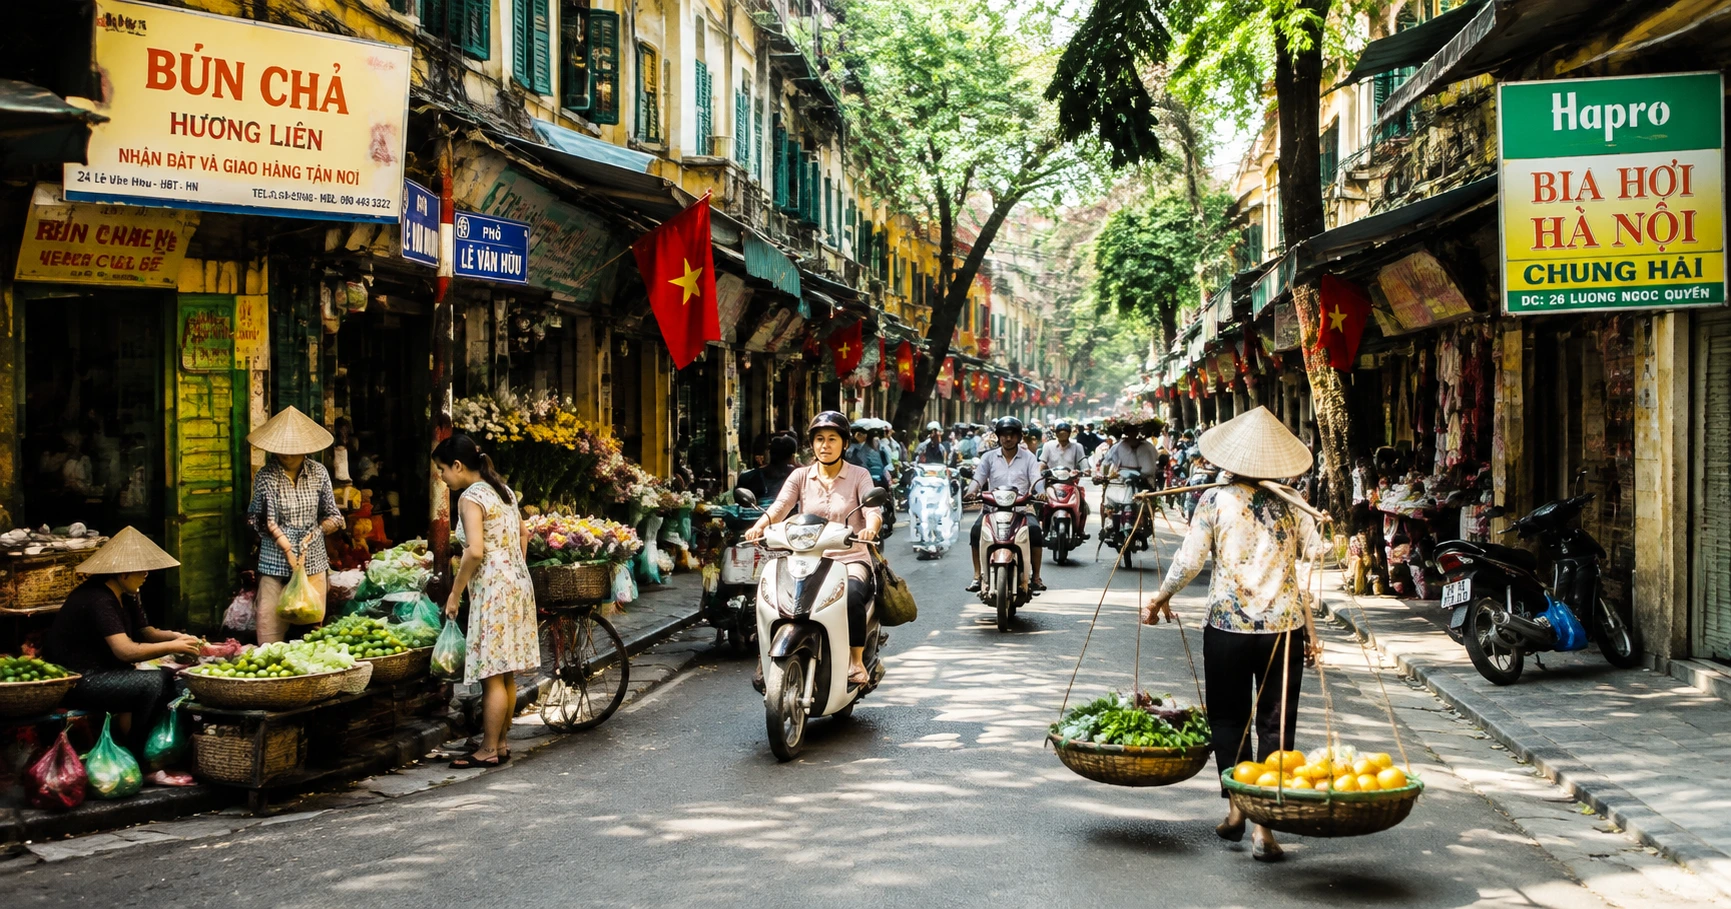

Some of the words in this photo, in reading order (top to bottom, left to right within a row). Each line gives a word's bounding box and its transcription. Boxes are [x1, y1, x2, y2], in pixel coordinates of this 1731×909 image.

[146, 43, 245, 101] BÚN
[260, 62, 349, 115] CHẢ
[170, 112, 261, 143] HƯƠNG
[270, 121, 323, 151] LIÊN
[1552, 91, 1670, 142] Hapro
[77, 171, 91, 182] 24
[186, 181, 199, 192] HN
[223, 159, 258, 175] GIAO
[1530, 167, 1605, 203] BIA
[1530, 205, 1601, 250] HÀ
[1611, 201, 1699, 252] NỘI
[1523, 261, 1637, 285] CHUNG
[1549, 294, 1565, 306] 26
[1570, 291, 1616, 304] LUONG
[1621, 290, 1659, 302] NGOC
